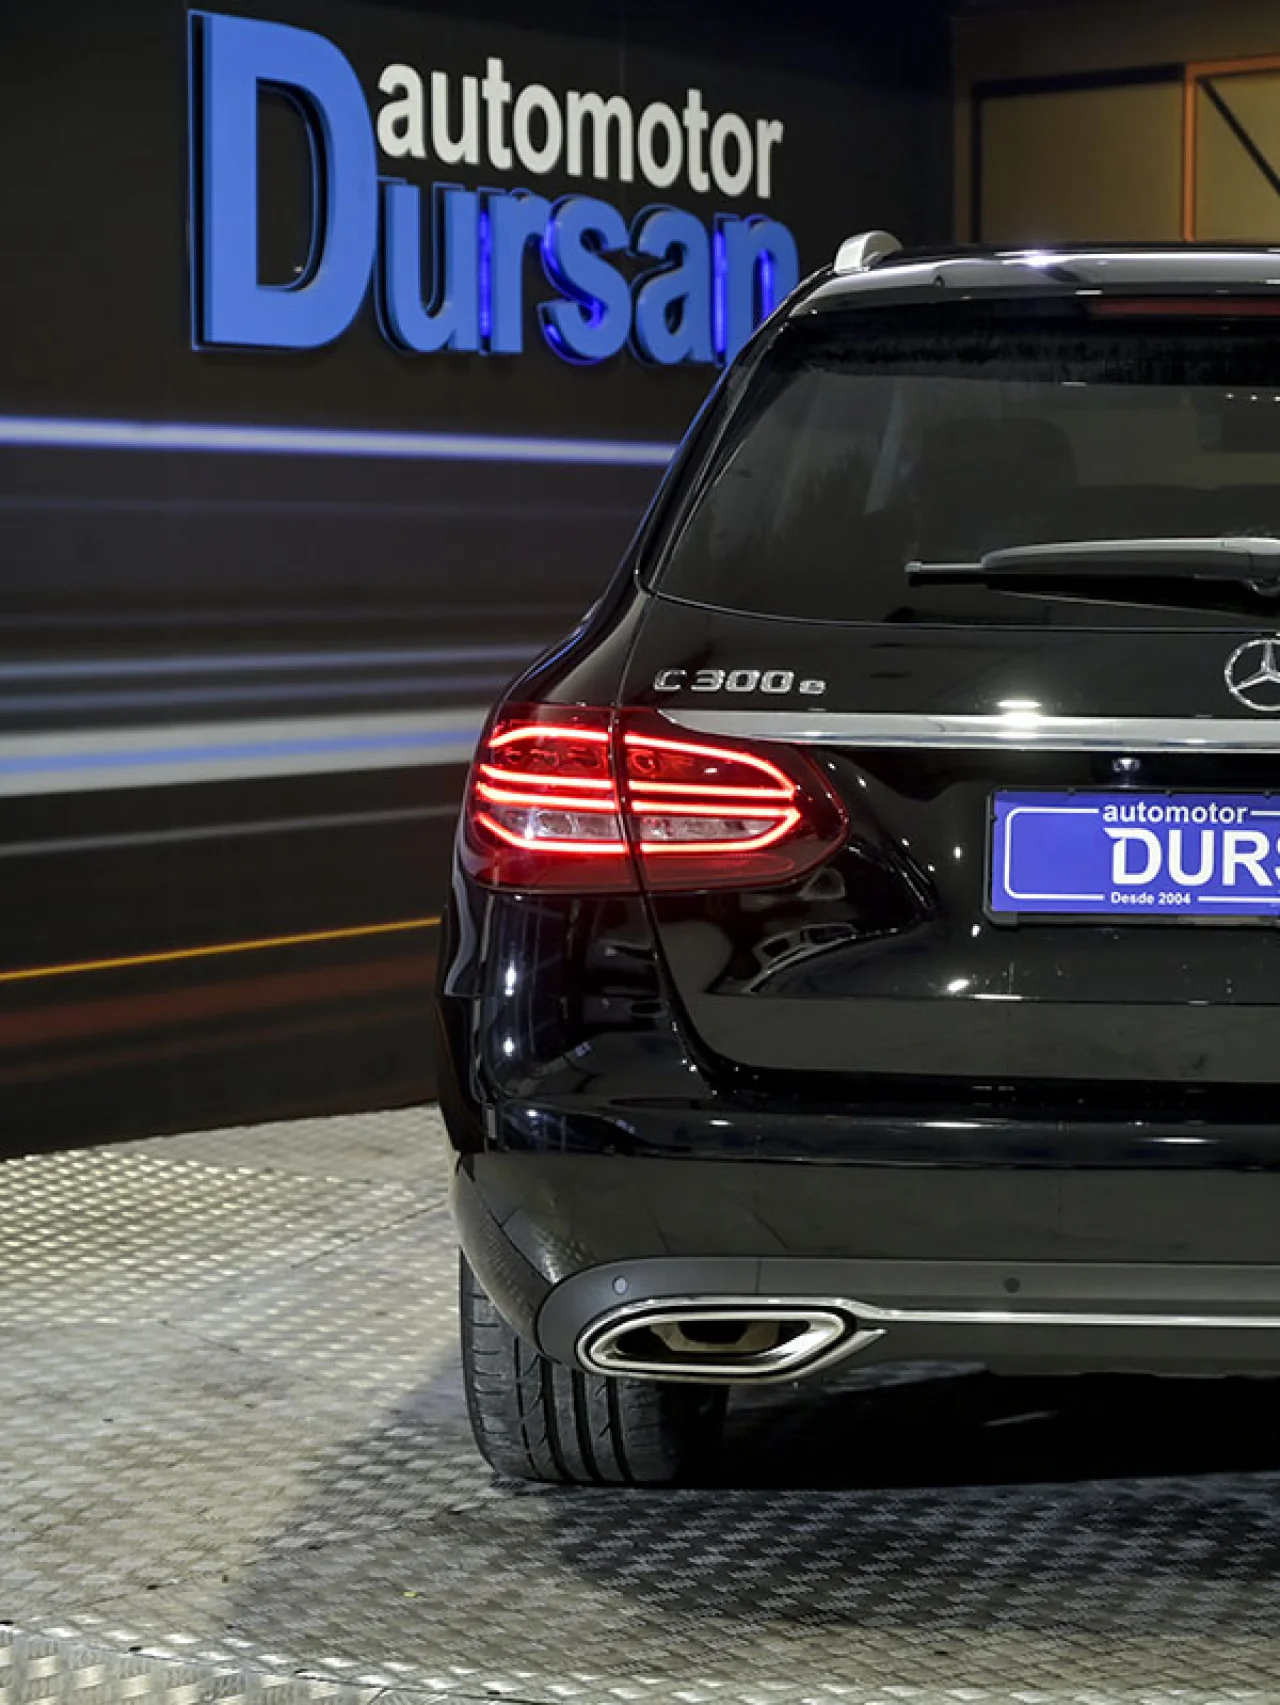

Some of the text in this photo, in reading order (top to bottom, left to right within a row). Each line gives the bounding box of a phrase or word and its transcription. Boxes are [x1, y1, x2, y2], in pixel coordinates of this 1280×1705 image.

[377, 57, 784, 199] automotor
[189, 8, 799, 366] Dursan
[654, 669, 827, 695] C 300 e
[1103, 801, 1249, 823] automotor
[1110, 891, 1192, 906] Desde 2004
